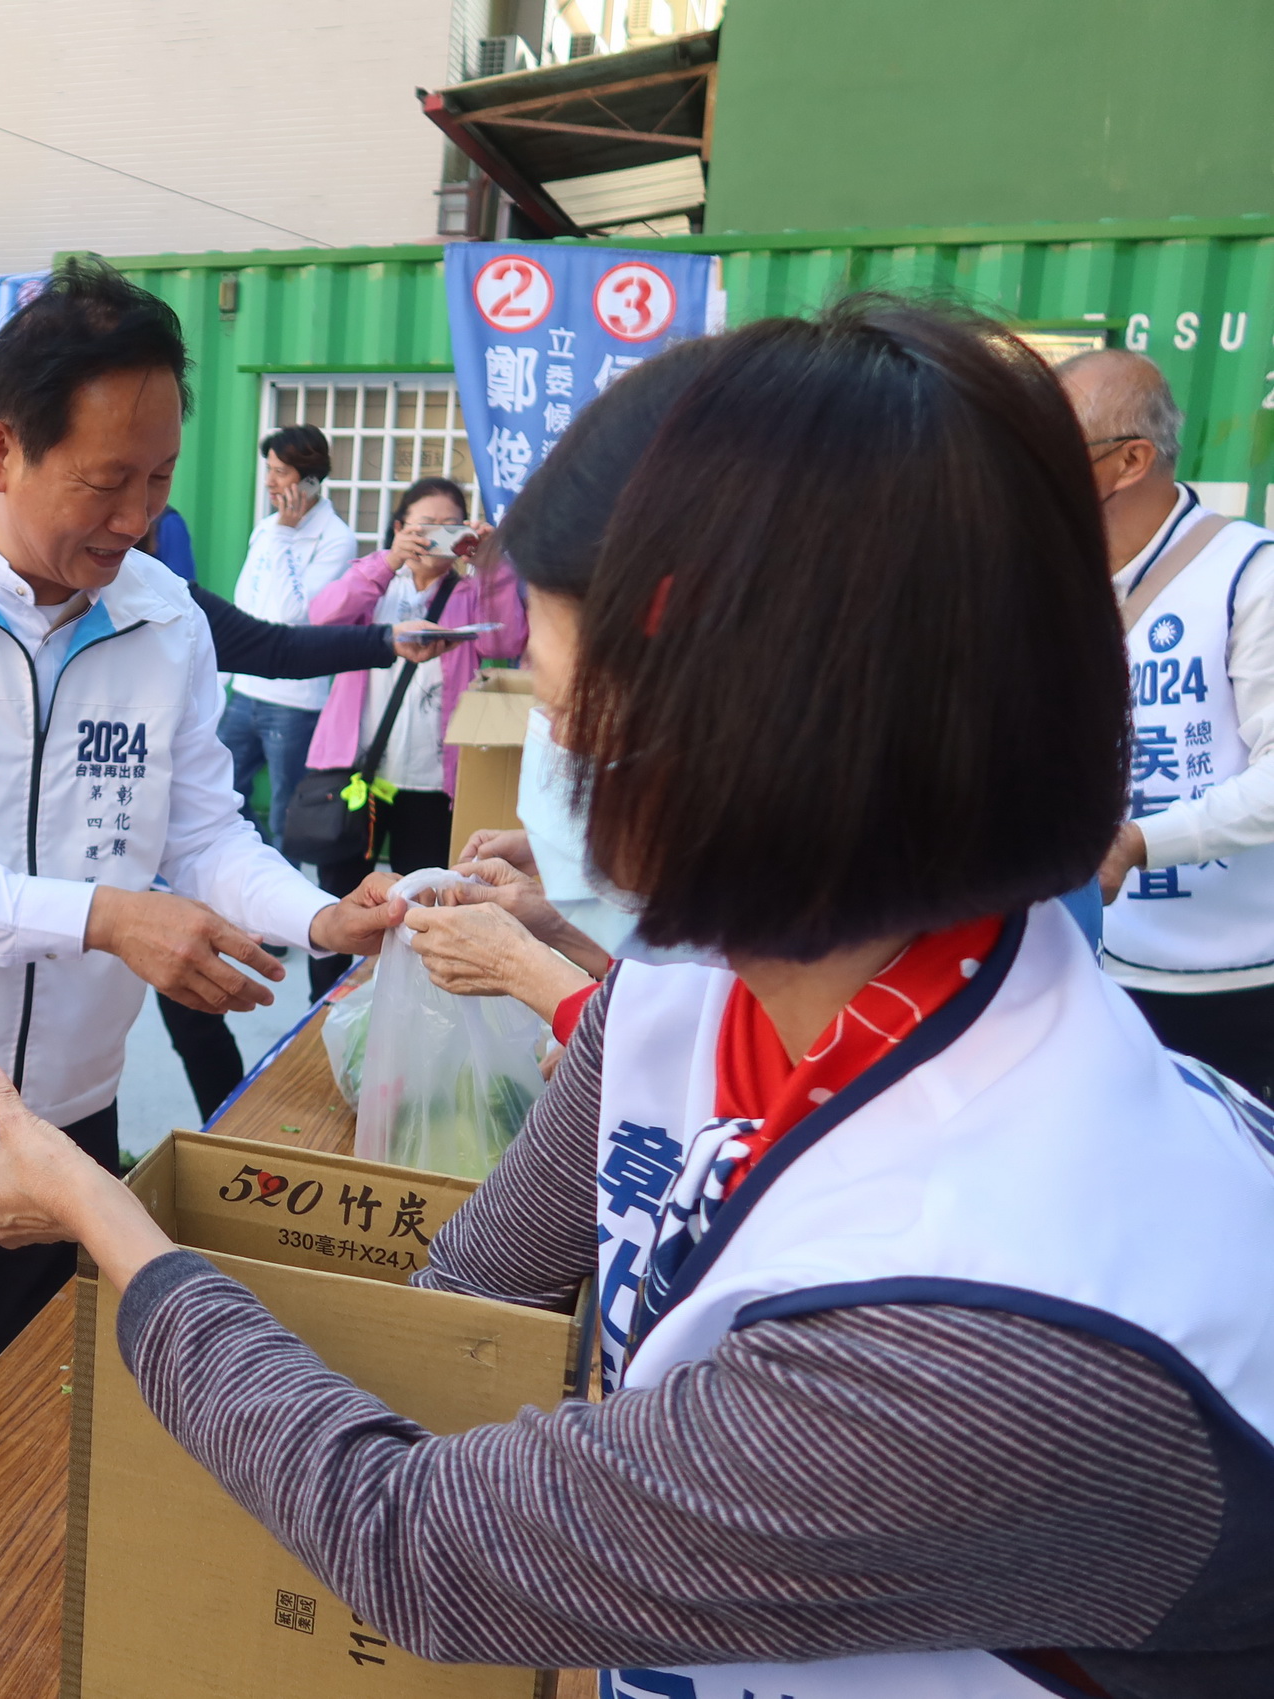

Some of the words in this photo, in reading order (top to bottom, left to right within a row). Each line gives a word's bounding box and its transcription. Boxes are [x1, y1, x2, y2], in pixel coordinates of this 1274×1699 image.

[489, 257, 533, 318] 2
[607, 275, 653, 335] 3
[1083, 311, 1248, 352] GSU
[541, 326, 576, 461] 立委候
[483, 345, 540, 527] 鄭俊
[77, 719, 148, 764] 2024
[75, 763, 146, 779] 台灣再出發
[111, 784, 133, 857] 彰化縣
[219, 1164, 324, 1216] 520
[277, 1228, 419, 1272] 330毫升X24入
